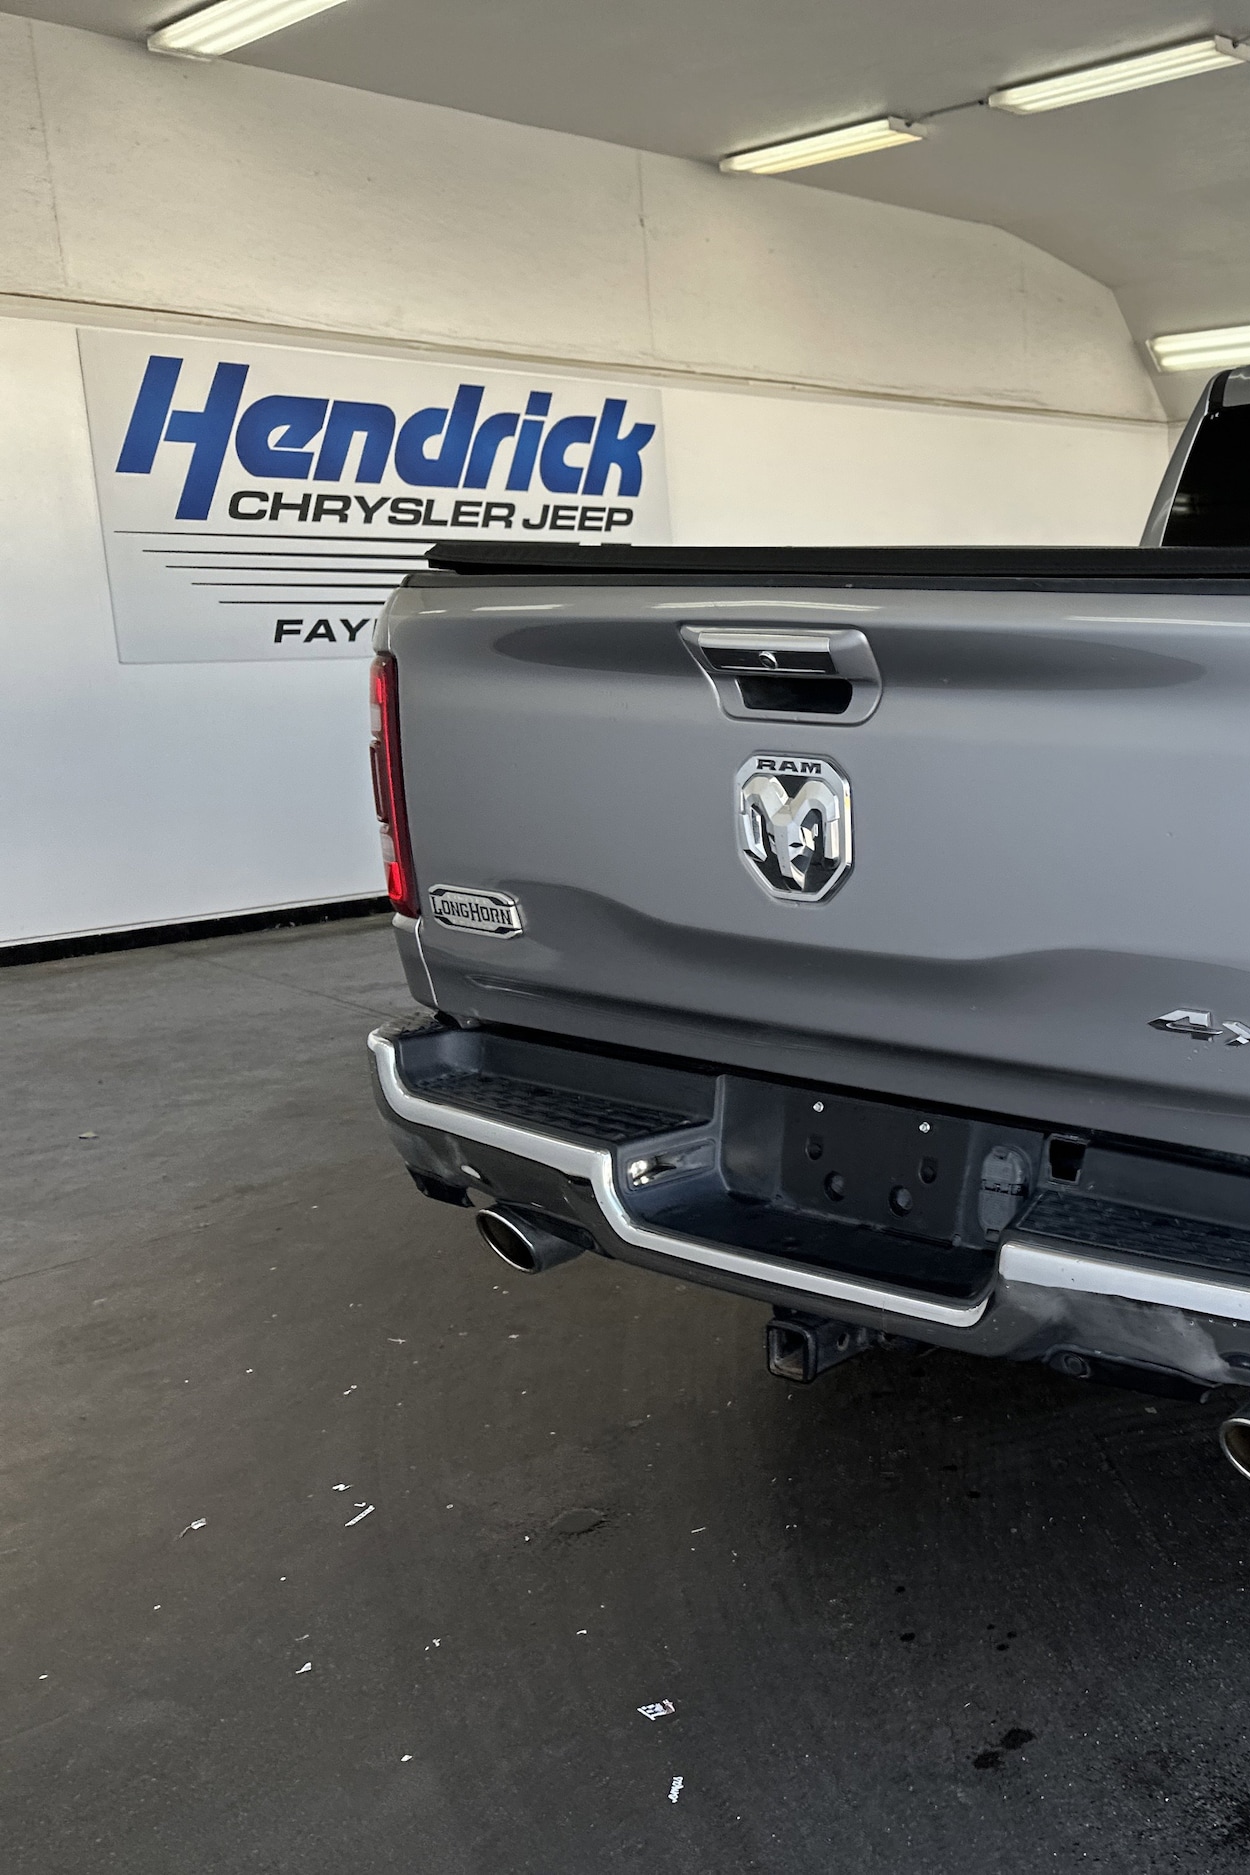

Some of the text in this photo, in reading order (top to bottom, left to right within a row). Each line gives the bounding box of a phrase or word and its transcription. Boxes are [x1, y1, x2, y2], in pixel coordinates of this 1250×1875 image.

[115, 355, 656, 521] Hendrick
[228, 490, 634, 532] CHRYSLER JEEP
[274, 619, 377, 643] FAY
[756, 759, 822, 774] RAM
